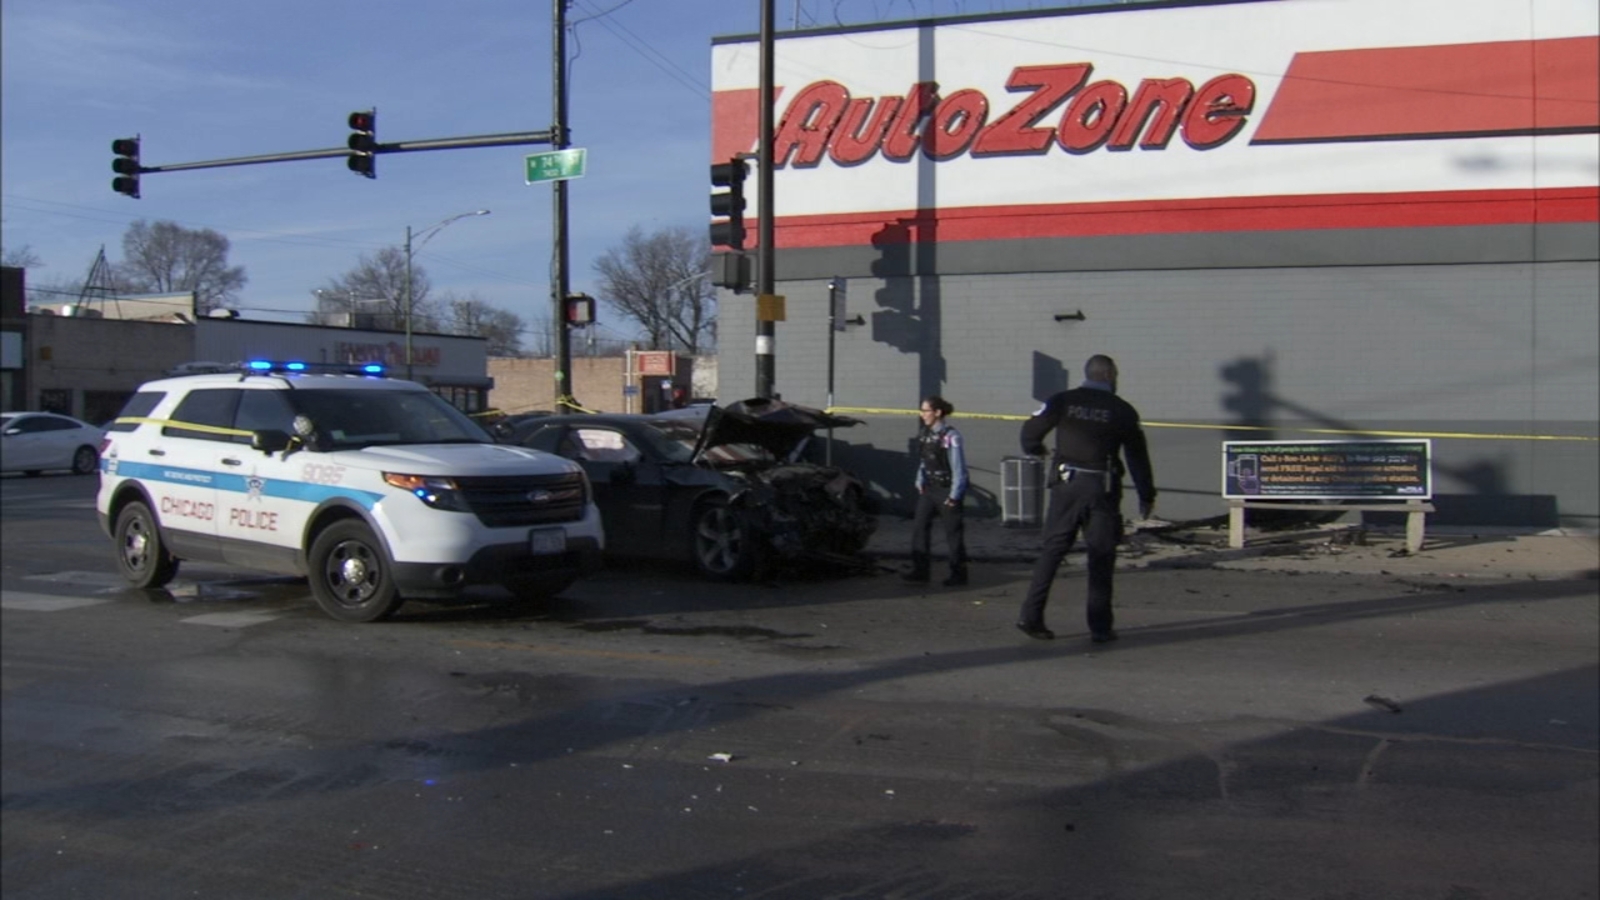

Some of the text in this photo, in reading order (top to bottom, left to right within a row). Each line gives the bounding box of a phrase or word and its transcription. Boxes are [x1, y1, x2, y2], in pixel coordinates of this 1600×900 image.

[774, 62, 1256, 169] AutoZone
[1067, 405, 1109, 423] POLICE
[160, 496, 278, 531] CHICAGO POLICE
